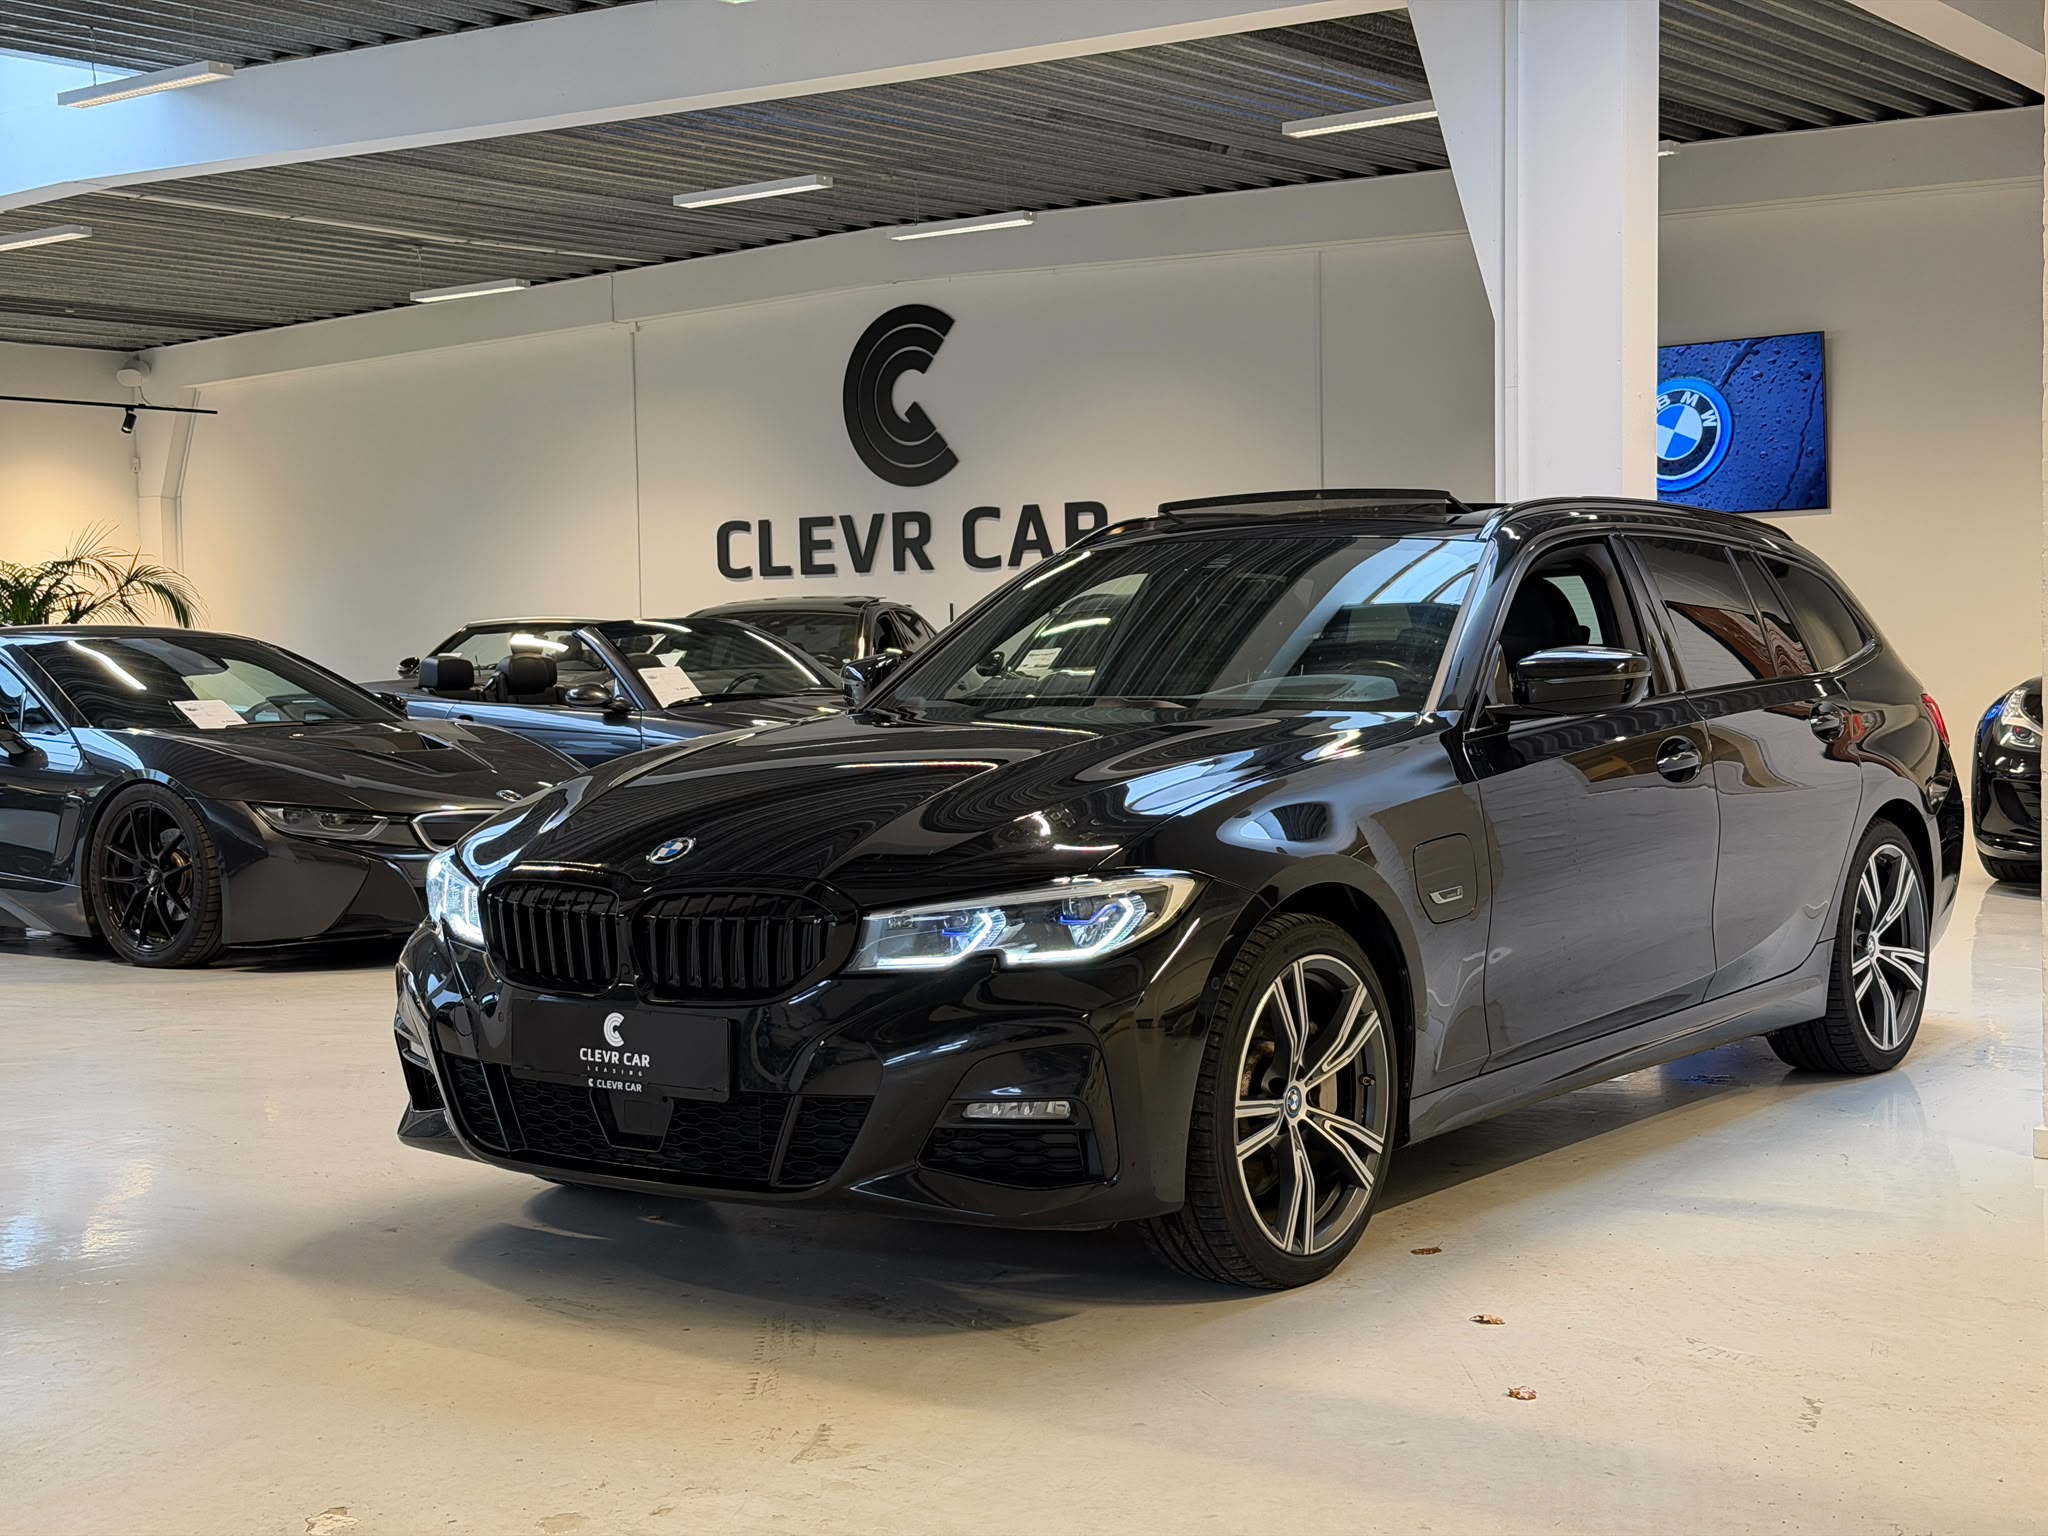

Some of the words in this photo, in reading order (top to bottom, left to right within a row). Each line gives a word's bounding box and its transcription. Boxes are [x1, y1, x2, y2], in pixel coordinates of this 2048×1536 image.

[1656, 391, 1717, 428] BMW
[717, 511, 935, 580] CLEVR
[579, 1047, 620, 1065] CLEVR
[623, 1052, 651, 1068] CAR
[596, 1079, 623, 1090] CLEVR
[625, 1082, 642, 1093] CAR
